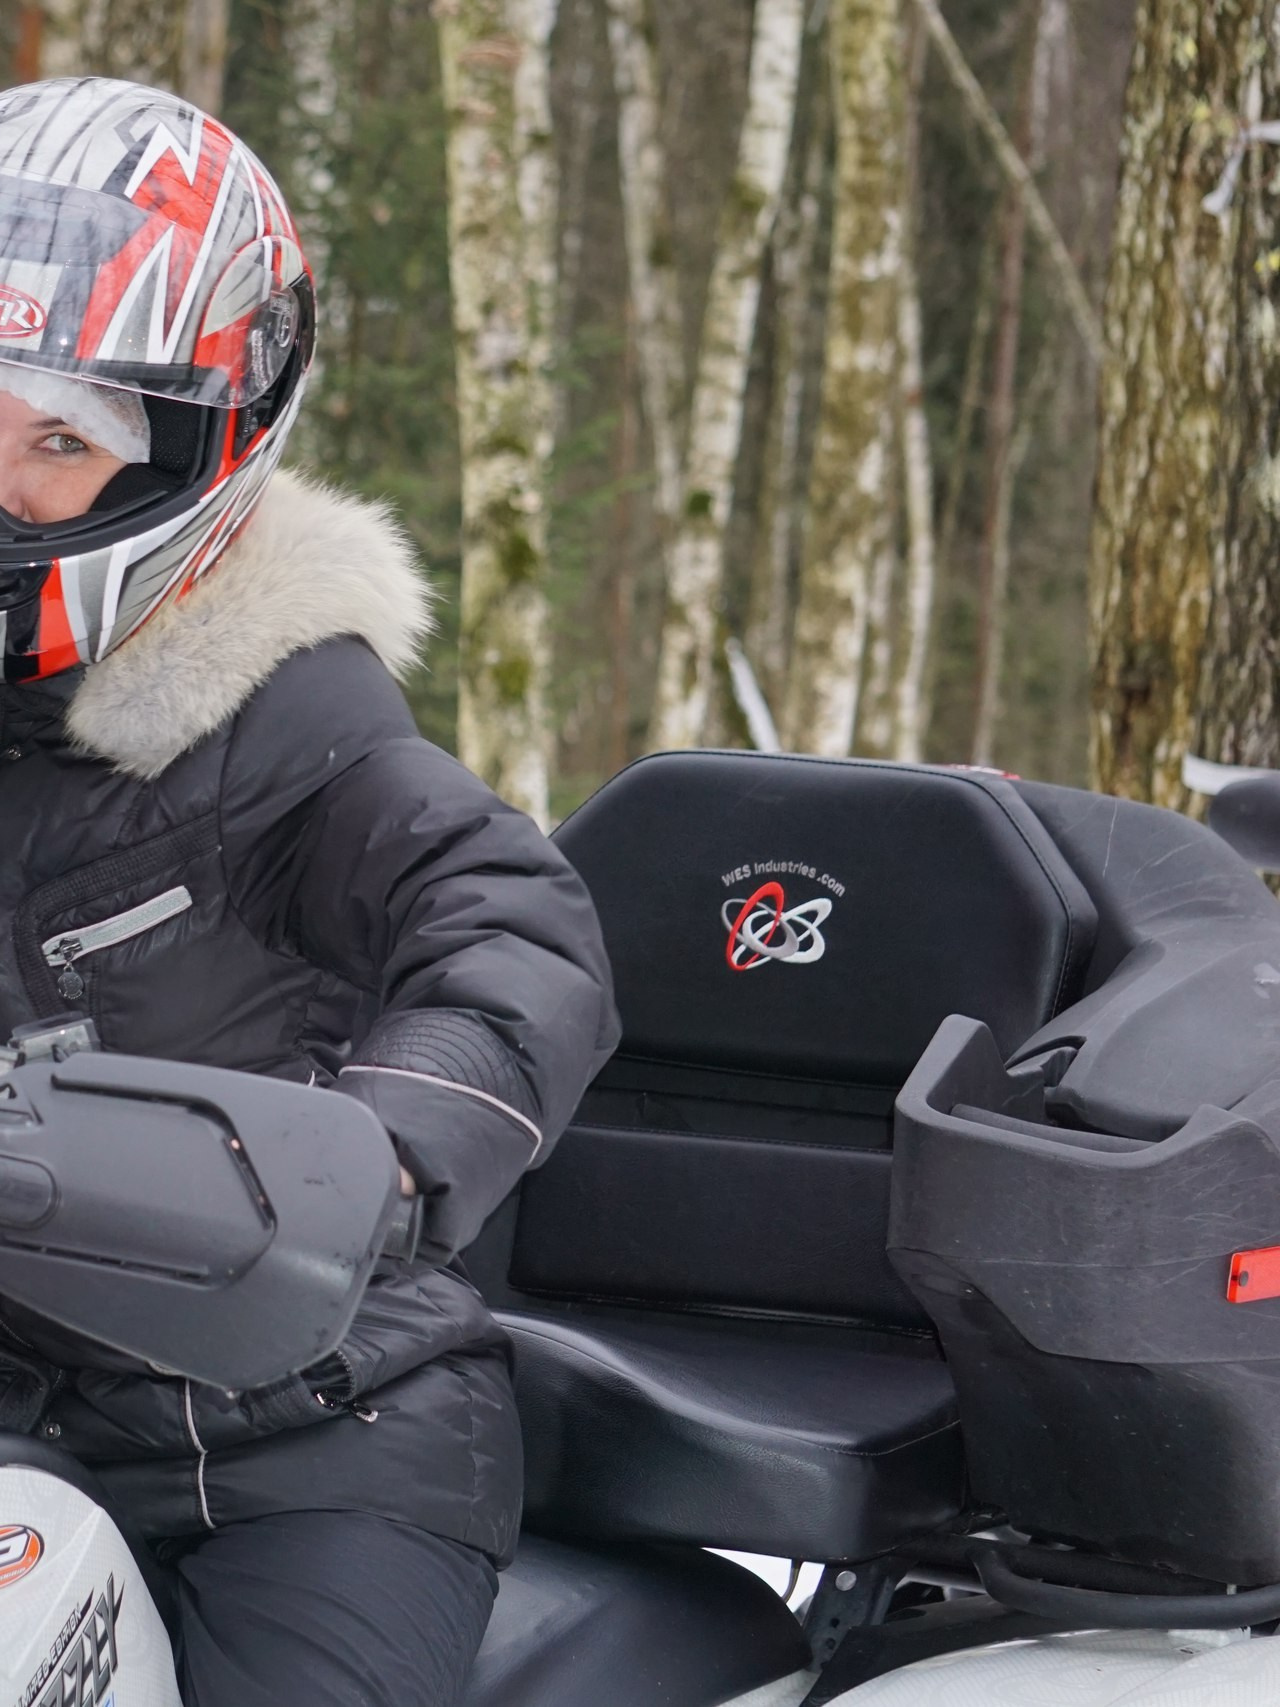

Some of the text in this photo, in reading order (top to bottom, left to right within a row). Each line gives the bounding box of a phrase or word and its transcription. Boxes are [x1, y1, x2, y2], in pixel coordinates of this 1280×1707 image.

[721, 860, 845, 897] WES Industries .com
[48, 1602, 82, 1666] EDITION
